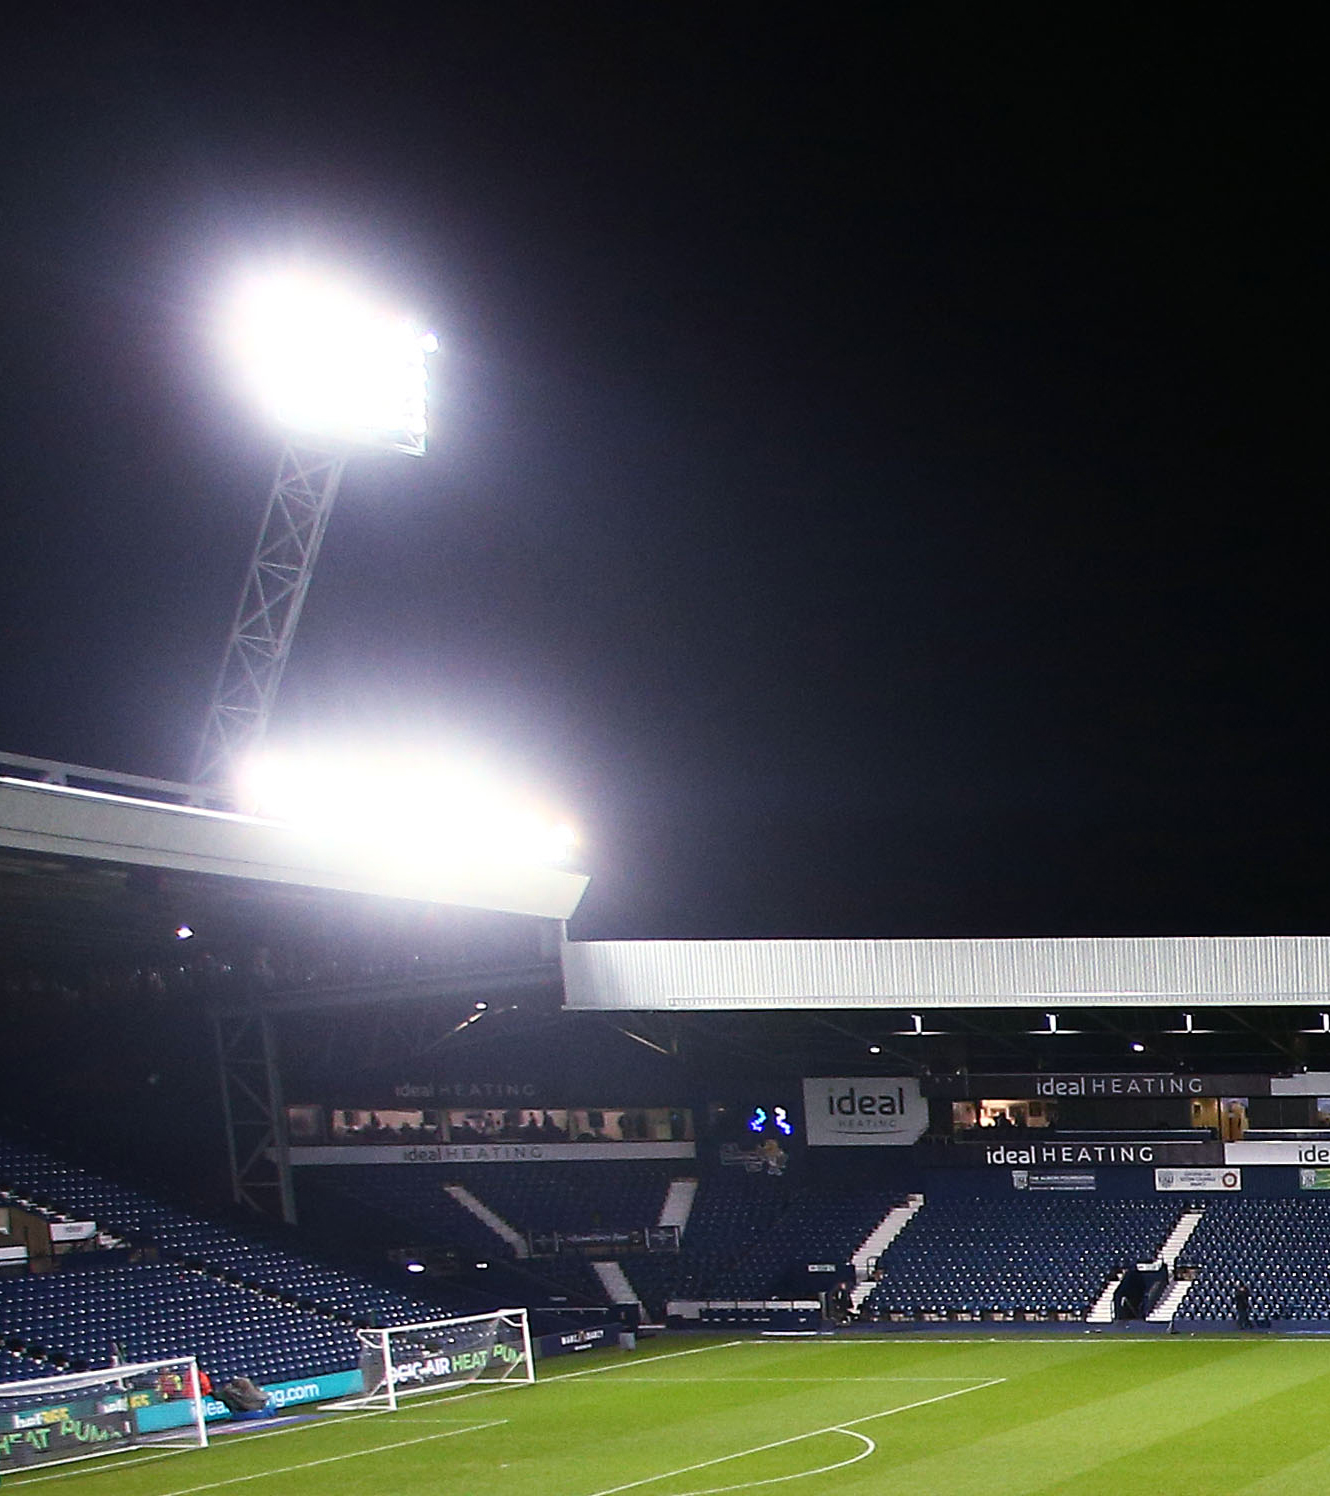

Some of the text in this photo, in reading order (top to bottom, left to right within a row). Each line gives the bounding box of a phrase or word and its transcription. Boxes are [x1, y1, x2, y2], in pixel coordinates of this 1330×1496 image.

[1037, 1077, 1202, 1095] ideal HEATING
[829, 1087, 904, 1116] ideal
[987, 1146, 1152, 1164] ideal HEATING
